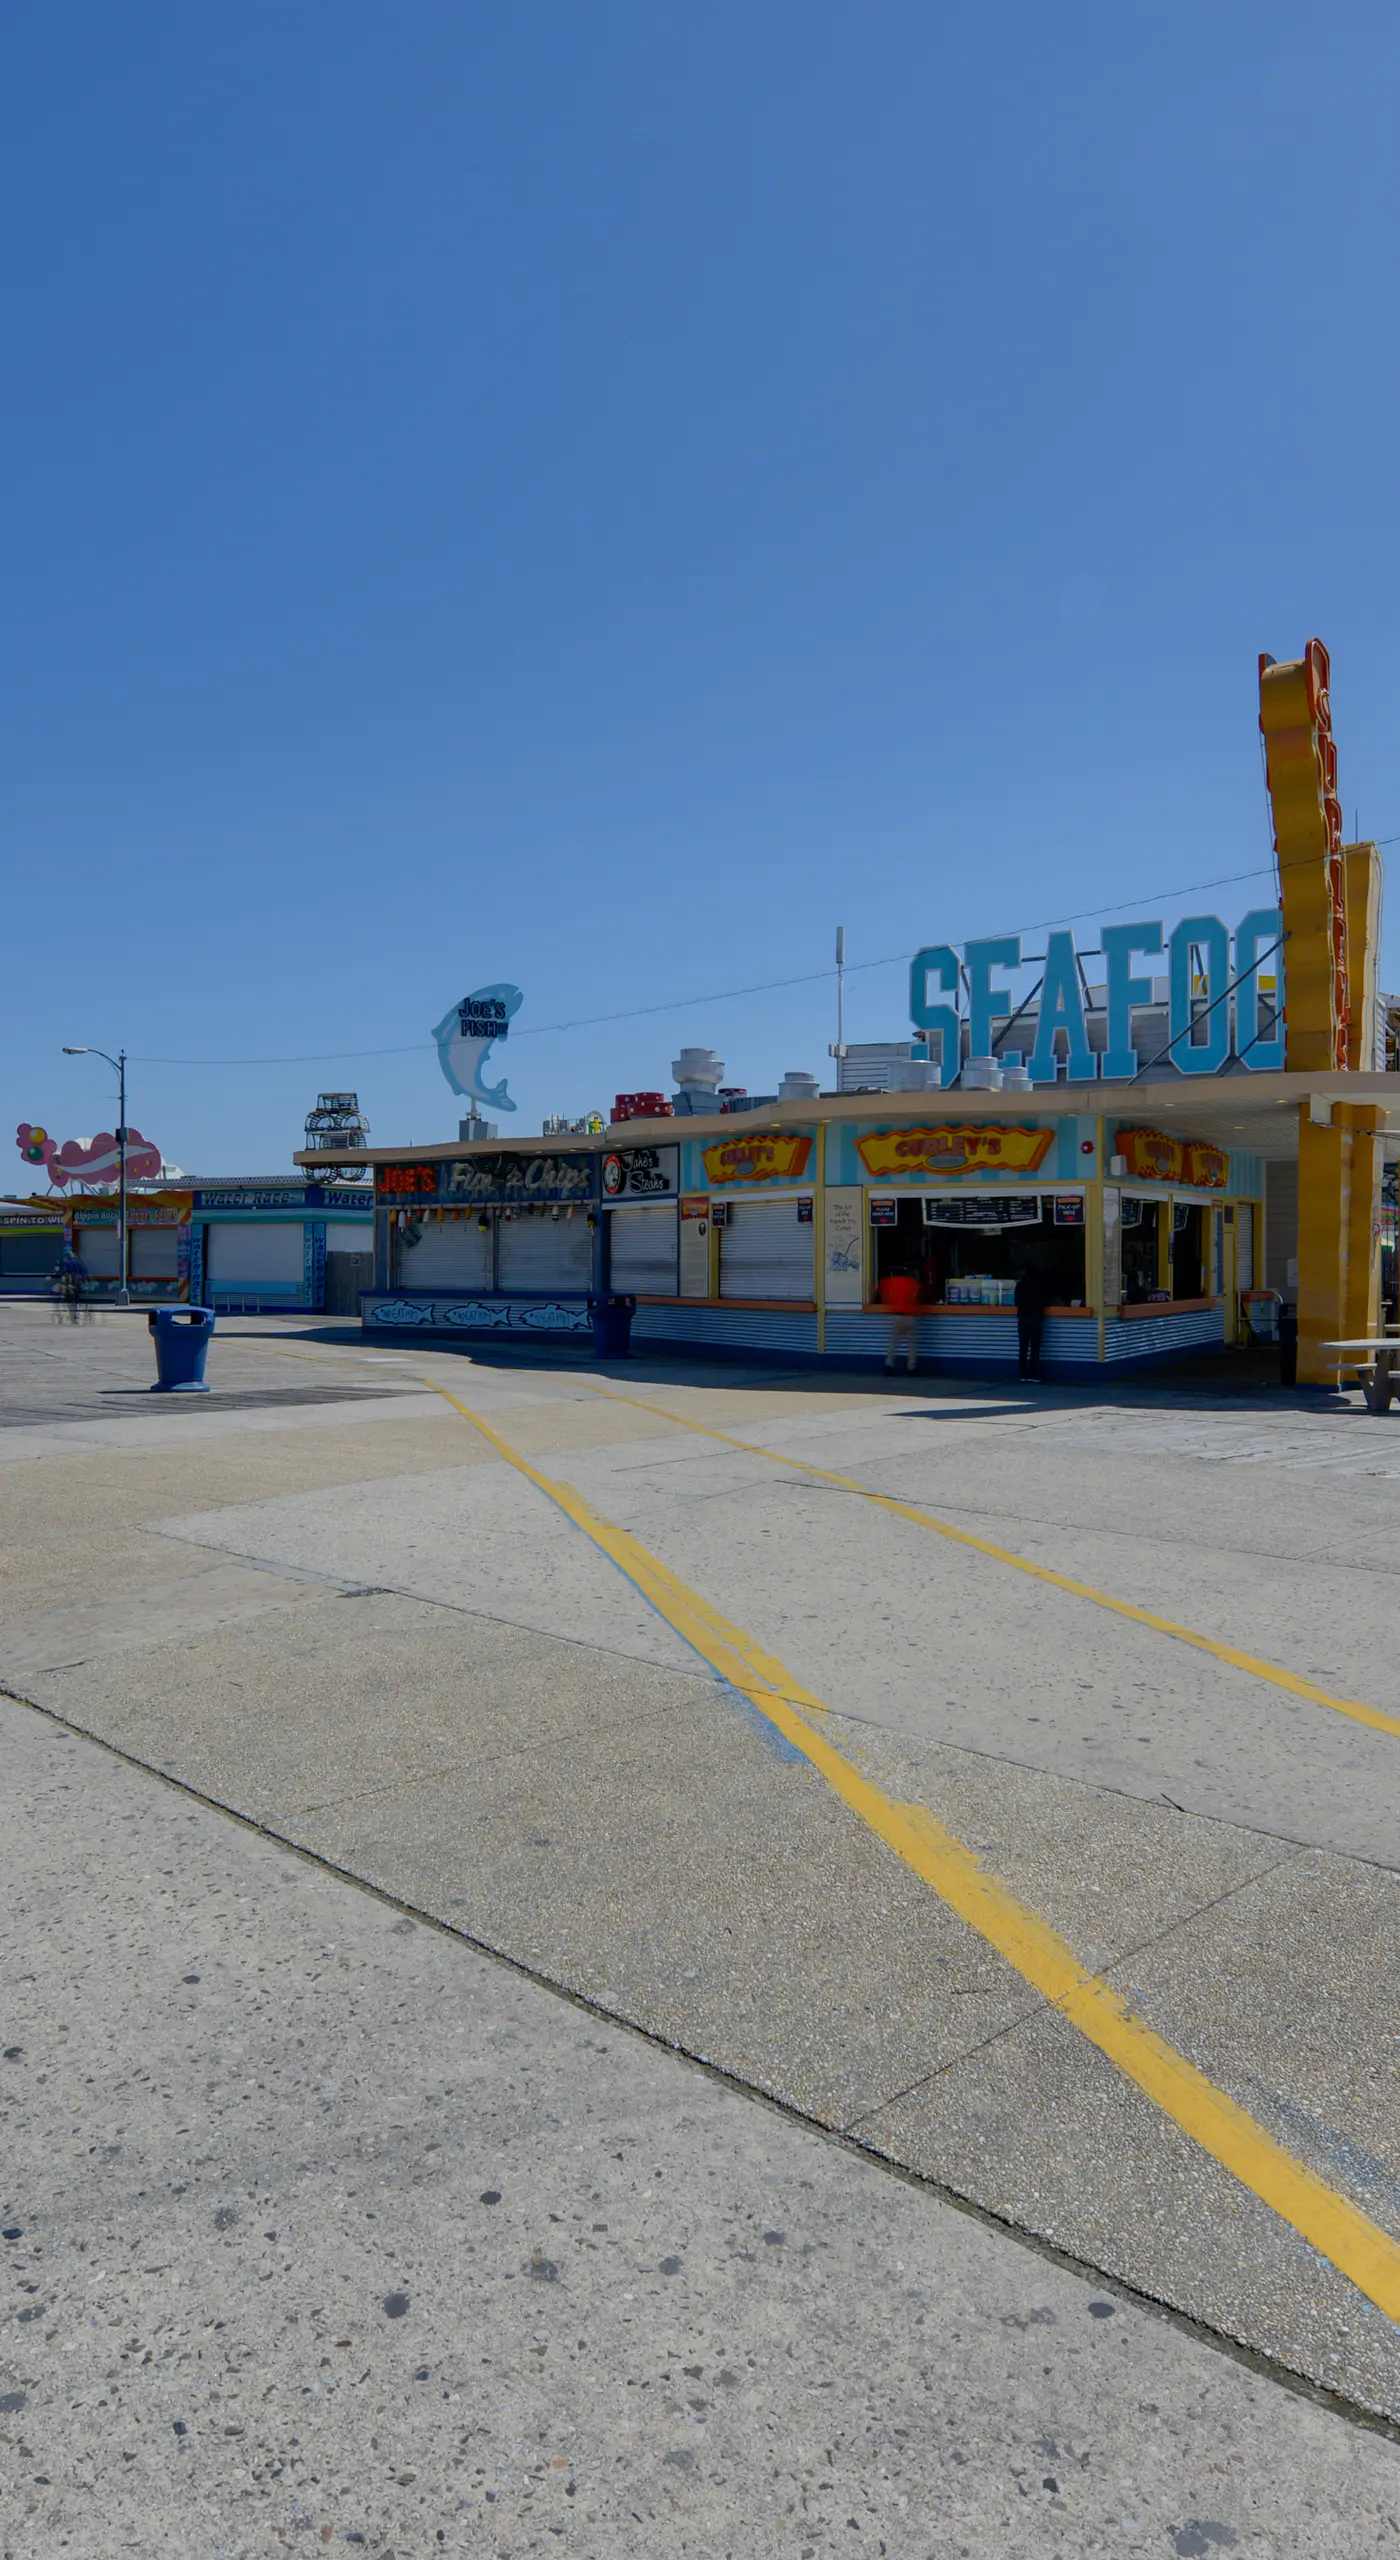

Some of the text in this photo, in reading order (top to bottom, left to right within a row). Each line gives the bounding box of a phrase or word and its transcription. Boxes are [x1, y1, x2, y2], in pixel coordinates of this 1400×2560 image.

[459, 997, 506, 1019] JOE'S
[461, 1019, 498, 1037] FISH
[895, 1136, 1002, 1157] CURLEY'S
[379, 1165, 437, 1194] JOE'S
[524, 1157, 593, 1199] Chips
[629, 1171, 665, 1193] Steaks
[204, 1190, 291, 1205] Water Race
[328, 1191, 373, 1206] Water
[3, 1217, 27, 1225] SPIN
